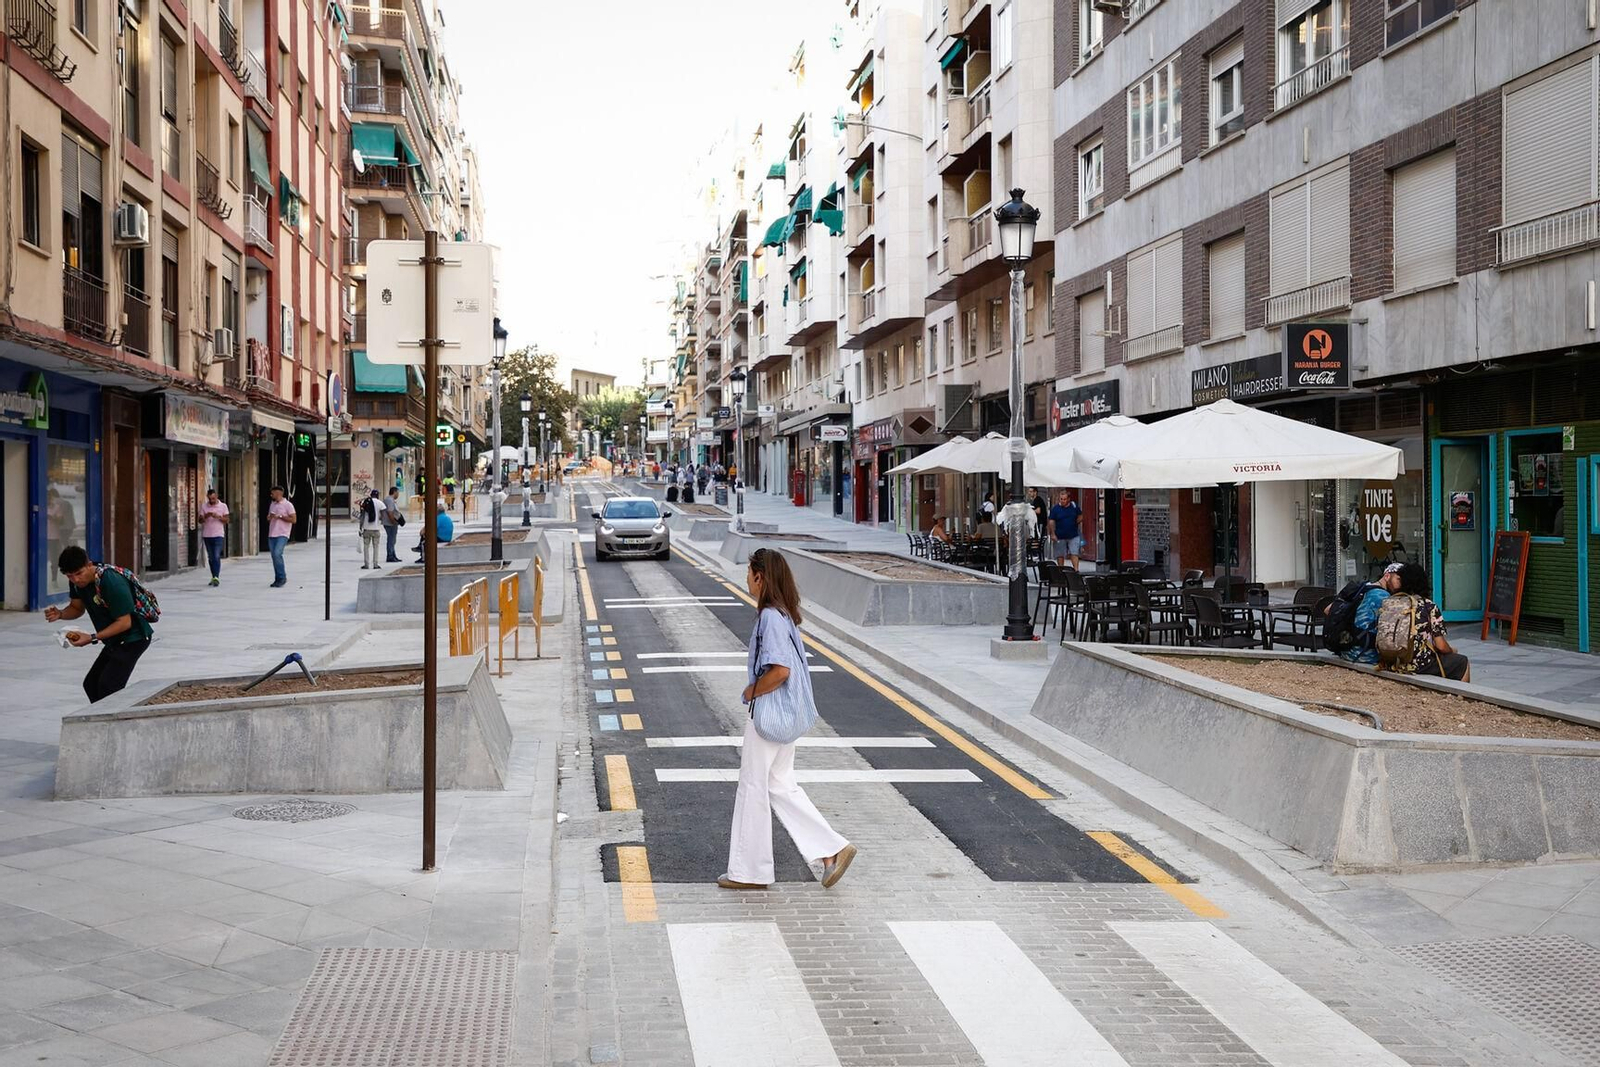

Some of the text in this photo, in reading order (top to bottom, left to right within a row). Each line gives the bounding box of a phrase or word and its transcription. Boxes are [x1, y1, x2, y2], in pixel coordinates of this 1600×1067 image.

[1294, 361, 1342, 369] NARANJA BURGER
[1193, 365, 1228, 391] MILANO
[1193, 388, 1228, 402] COSMETICS
[1060, 400, 1079, 420] mister
[1233, 464, 1282, 473] VICTORIA
[1364, 488, 1393, 508] TINTE
[1365, 513, 1393, 543] 10€
